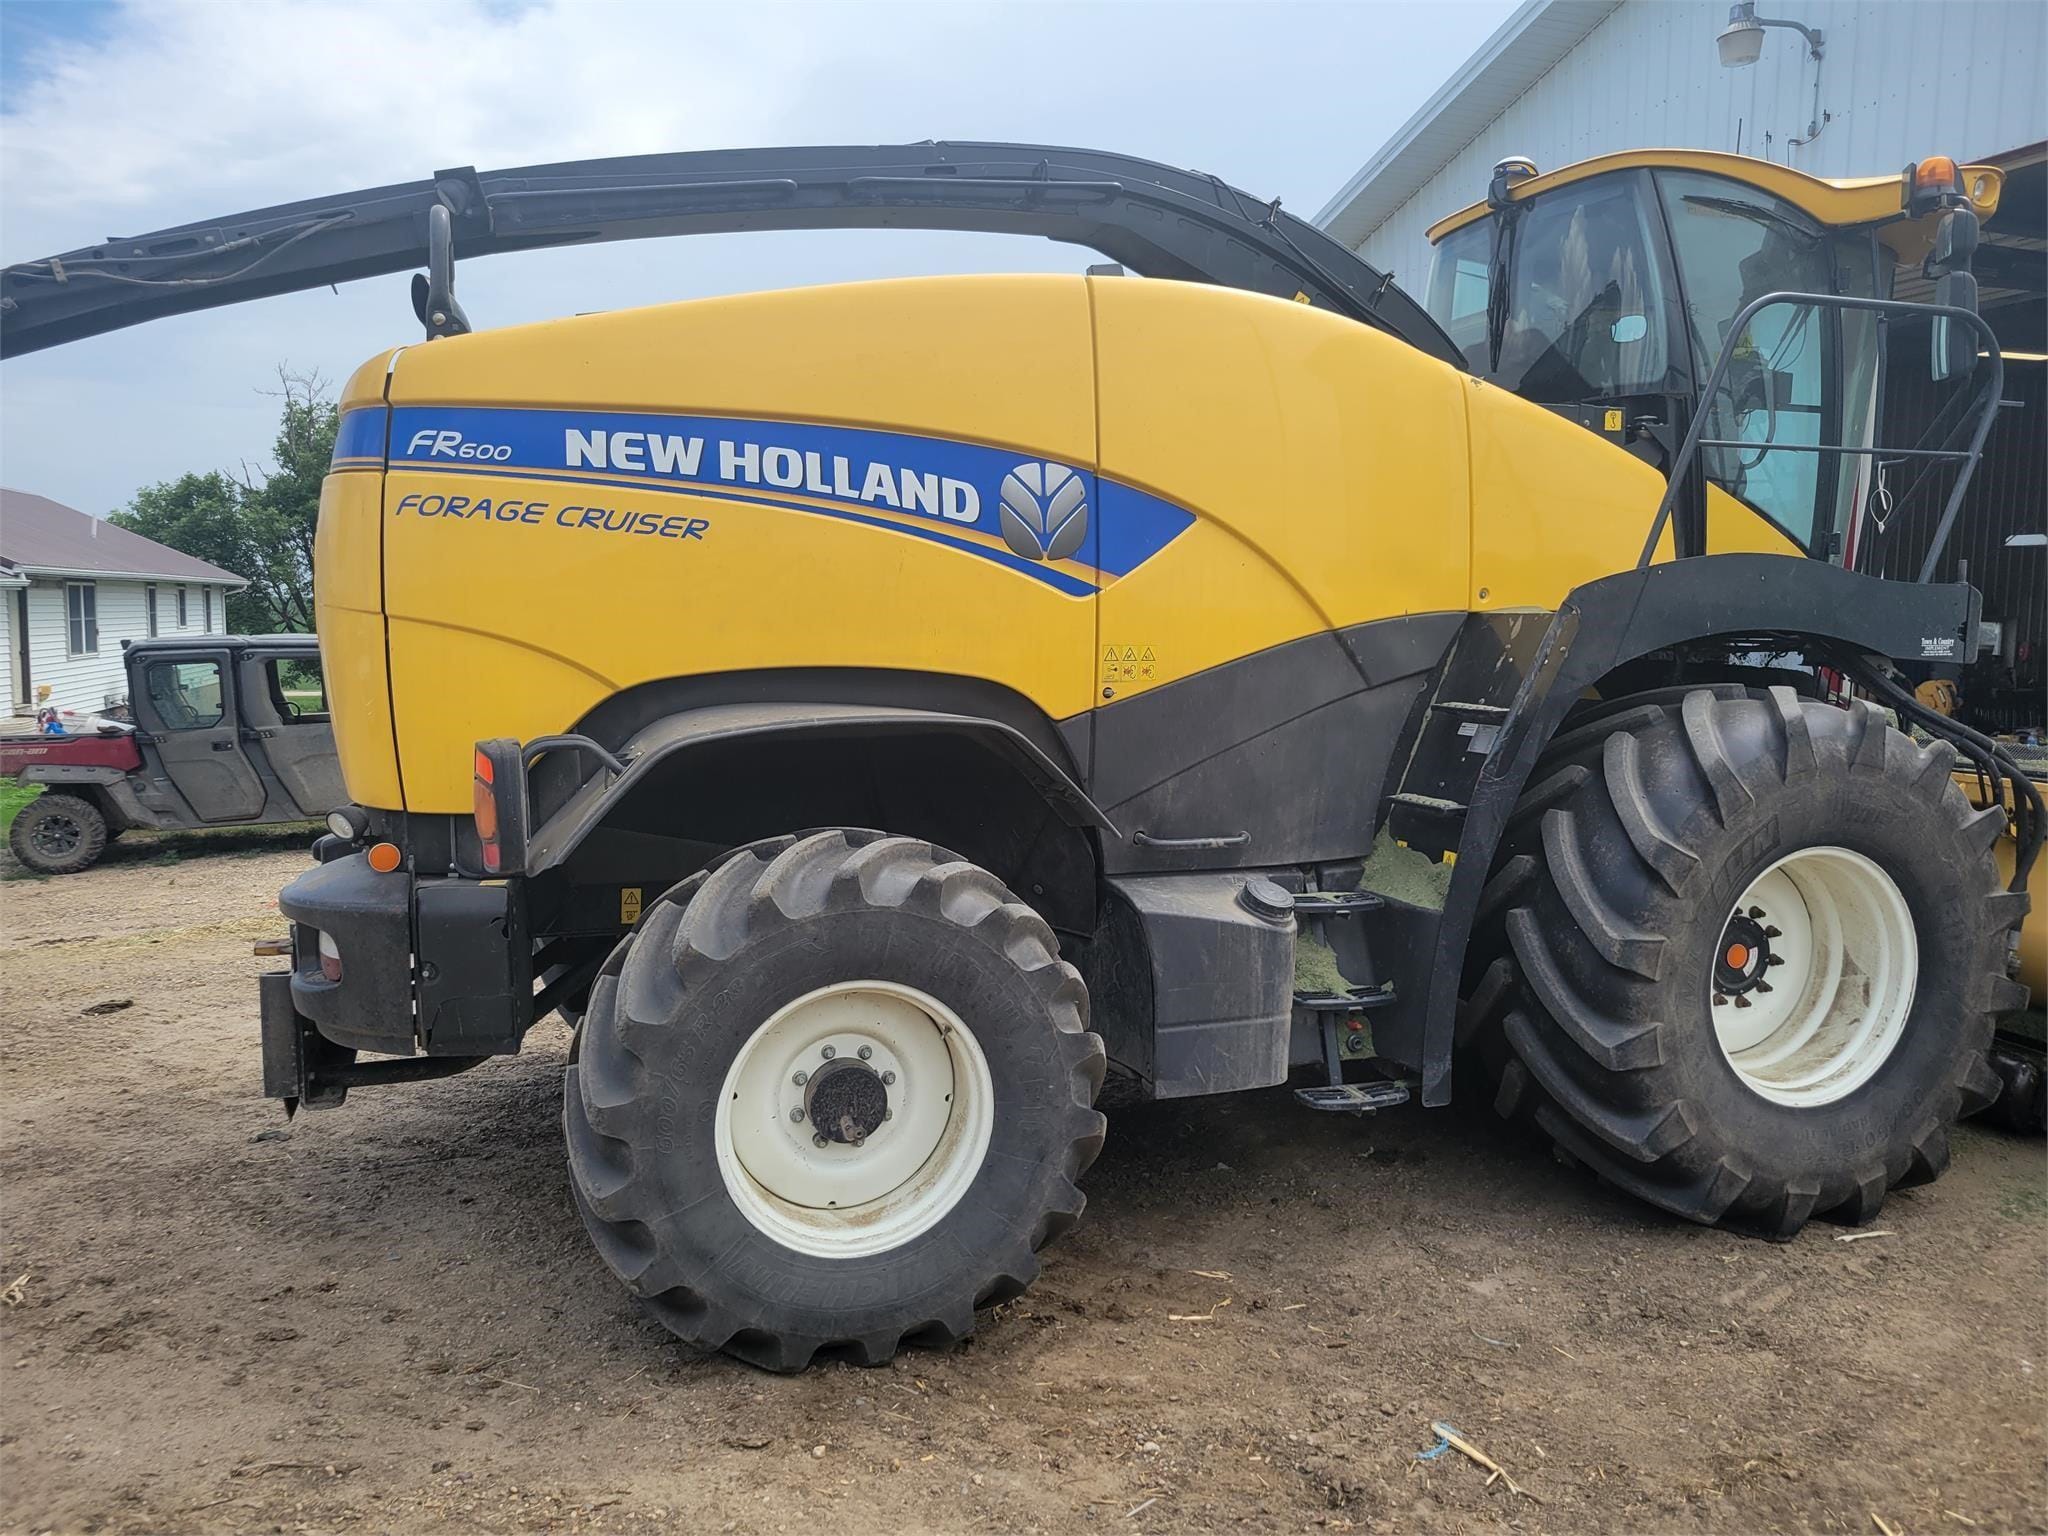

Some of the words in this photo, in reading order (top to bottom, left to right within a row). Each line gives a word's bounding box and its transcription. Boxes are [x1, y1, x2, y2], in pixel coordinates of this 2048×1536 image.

[406, 429, 513, 462] FR600
[565, 428, 704, 476] NEW
[719, 440, 981, 524] HOLLAND
[395, 494, 549, 524] FORAGE
[556, 505, 710, 541] CRUISER
